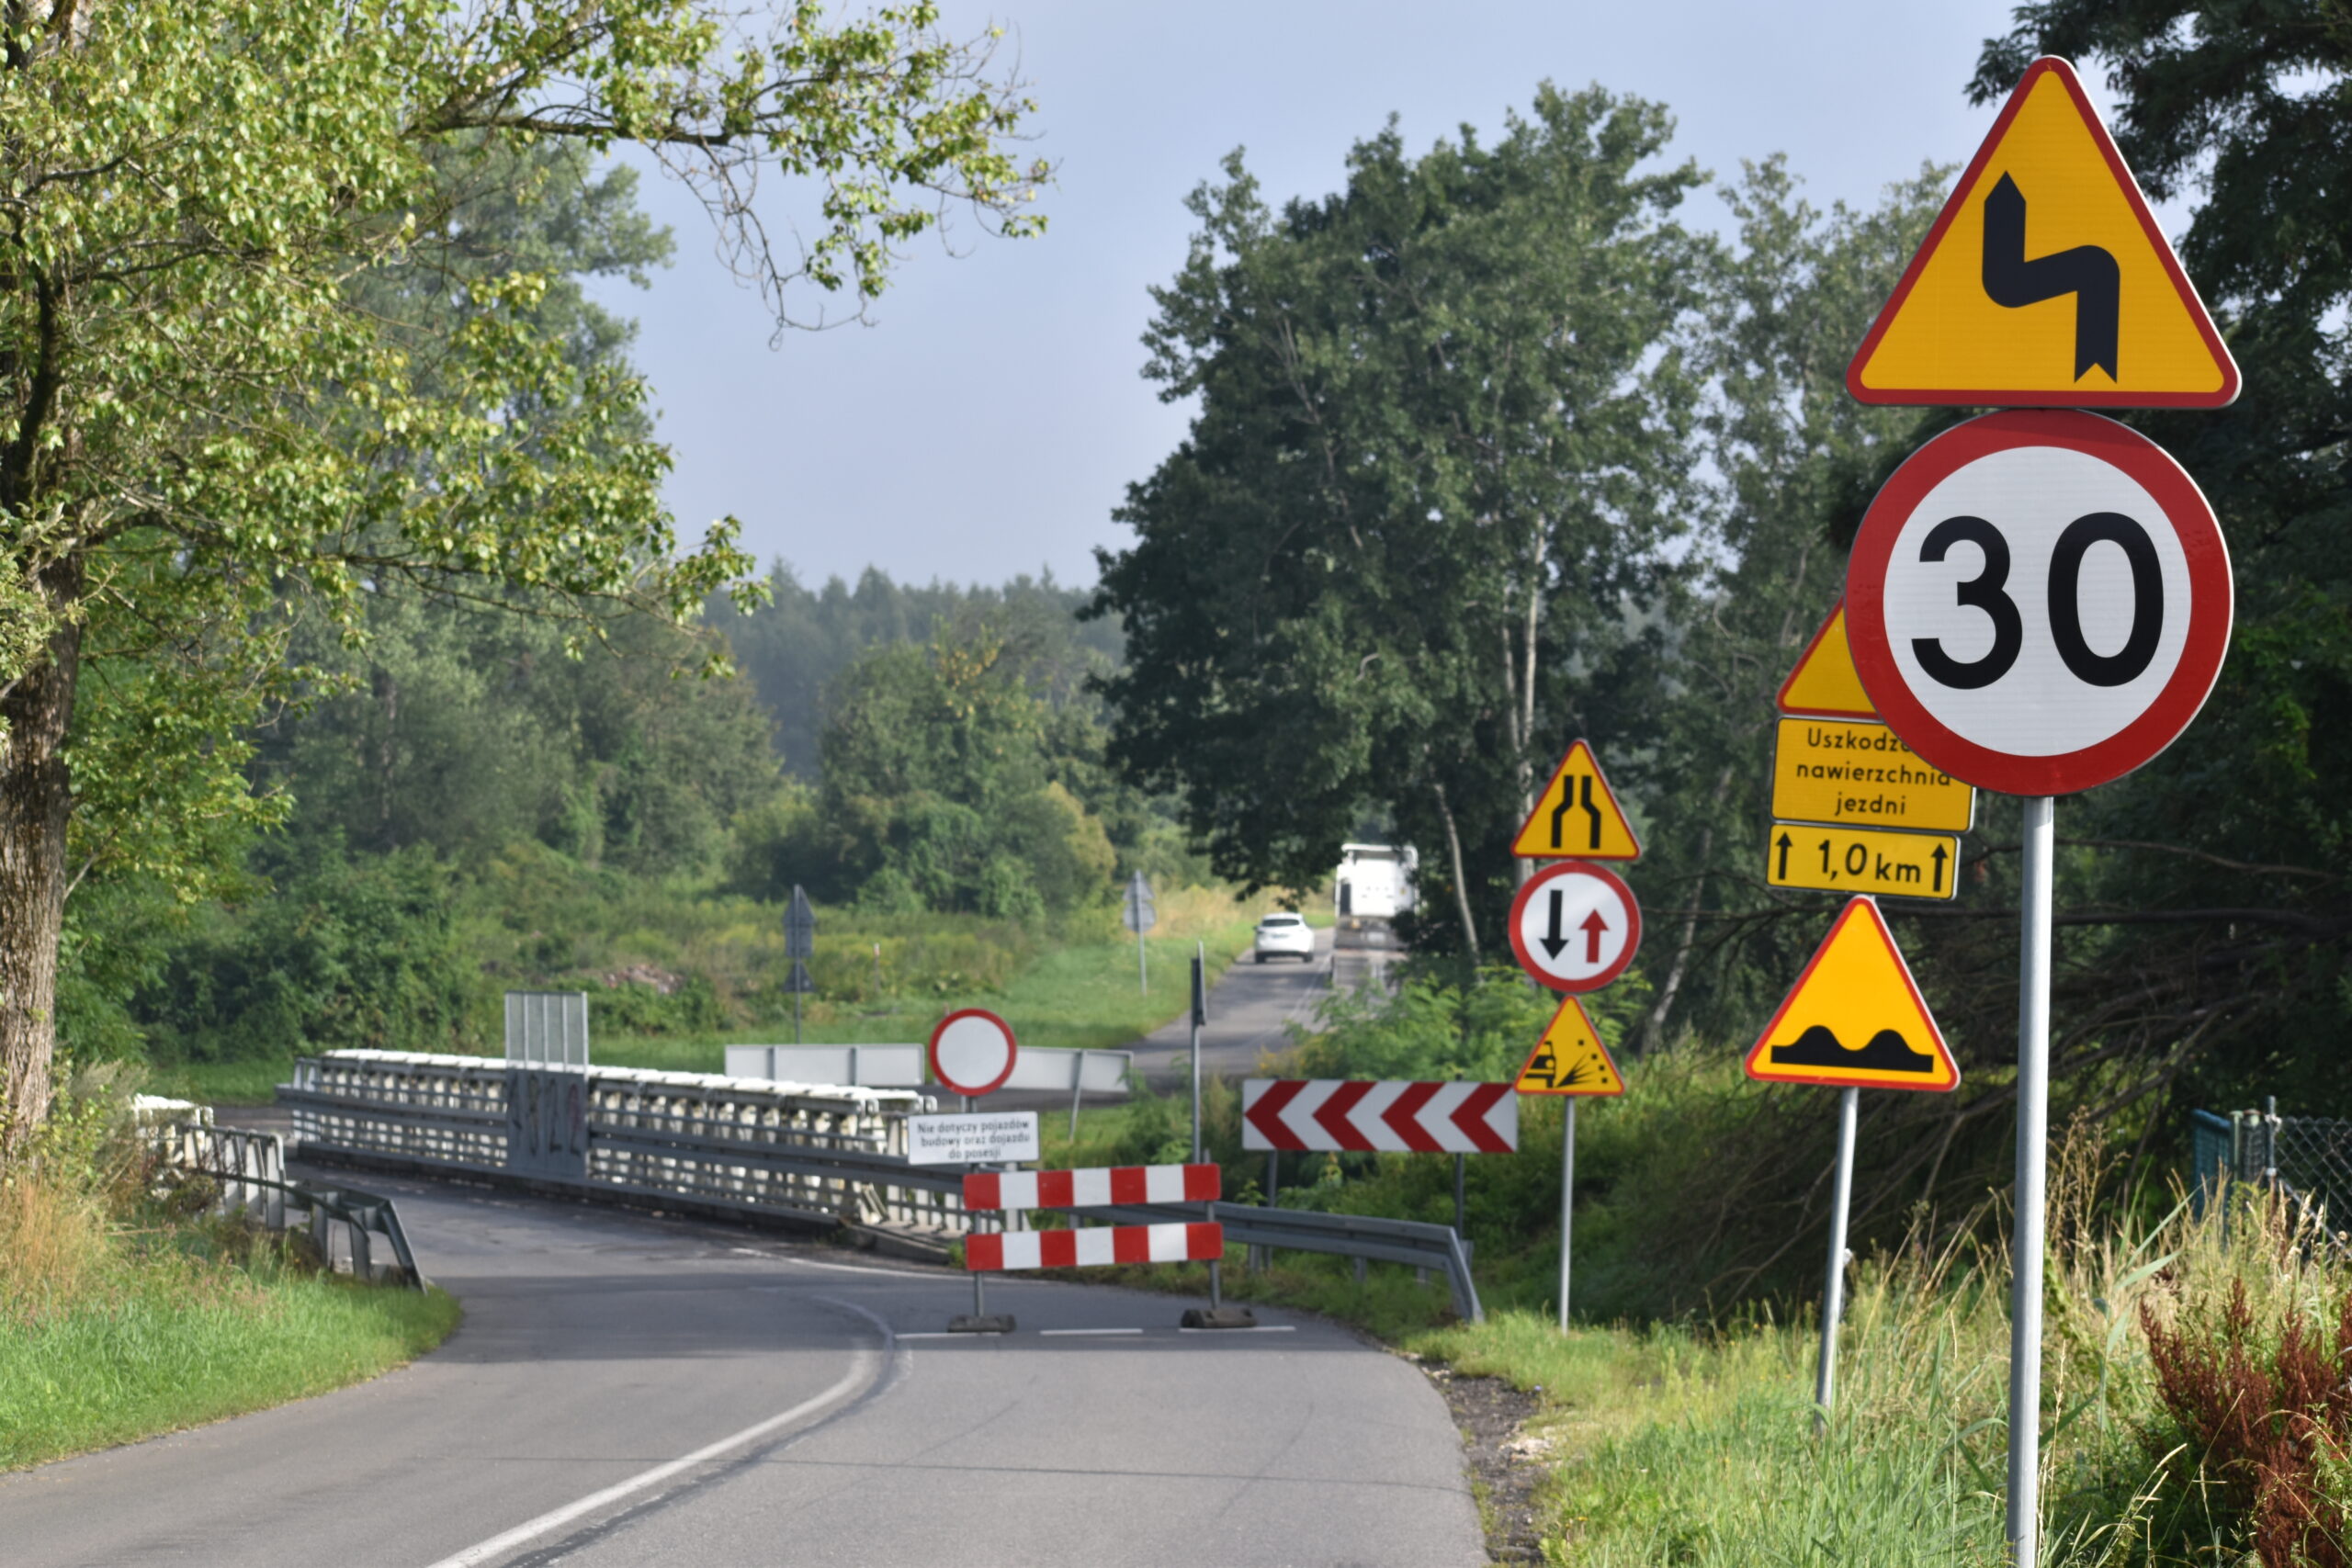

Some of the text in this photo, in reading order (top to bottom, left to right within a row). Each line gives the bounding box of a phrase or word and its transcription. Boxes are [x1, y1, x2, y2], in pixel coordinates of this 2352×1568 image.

[1911, 512, 2164, 690] 30
[1796, 761, 1951, 786] nawierzchnia
[1835, 792, 1906, 817] jezdni
[1818, 839, 1920, 883] 1,0 km
[918, 1122, 933, 1134] Nie
[937, 1121, 978, 1134] dotyczy
[921, 1133, 1030, 1147] budowy oraz dojazdu
[948, 1147, 1001, 1160] do posesji
